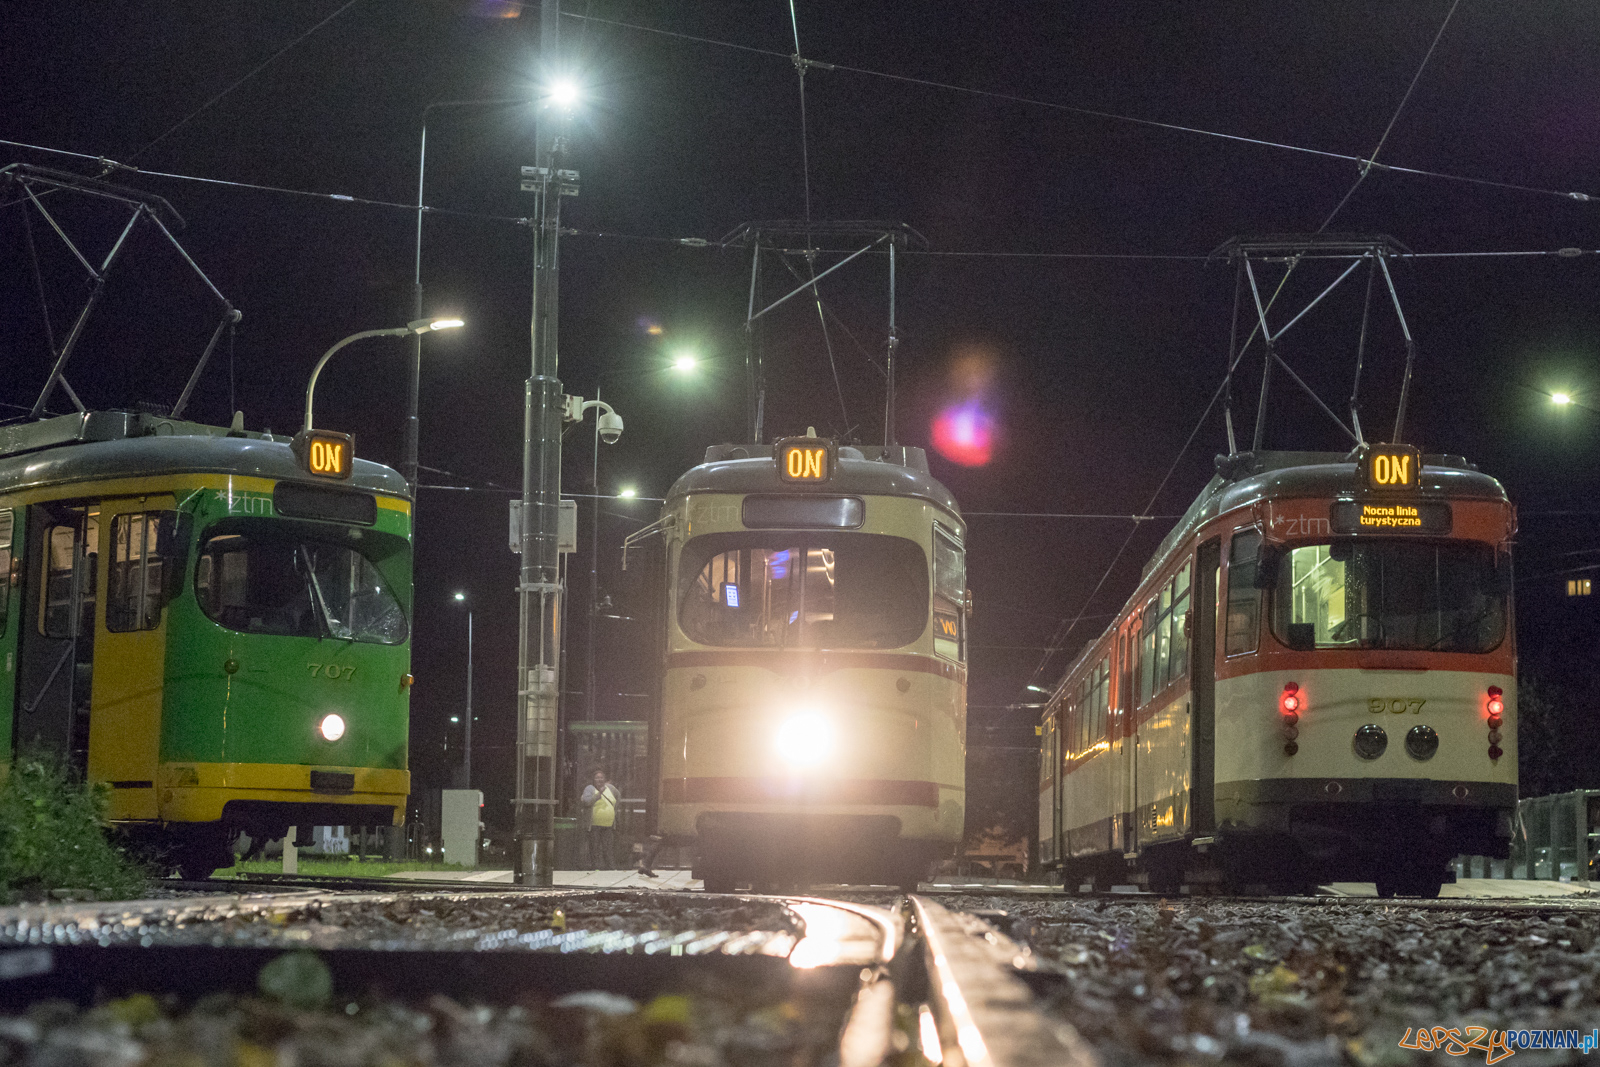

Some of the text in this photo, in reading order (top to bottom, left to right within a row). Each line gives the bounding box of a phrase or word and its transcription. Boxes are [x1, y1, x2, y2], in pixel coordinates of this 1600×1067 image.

[1363, 505, 1418, 516] Nocna linia
[1360, 515, 1421, 527] turystyczna
[306, 663, 358, 681] 707
[1368, 697, 1426, 714] 907
